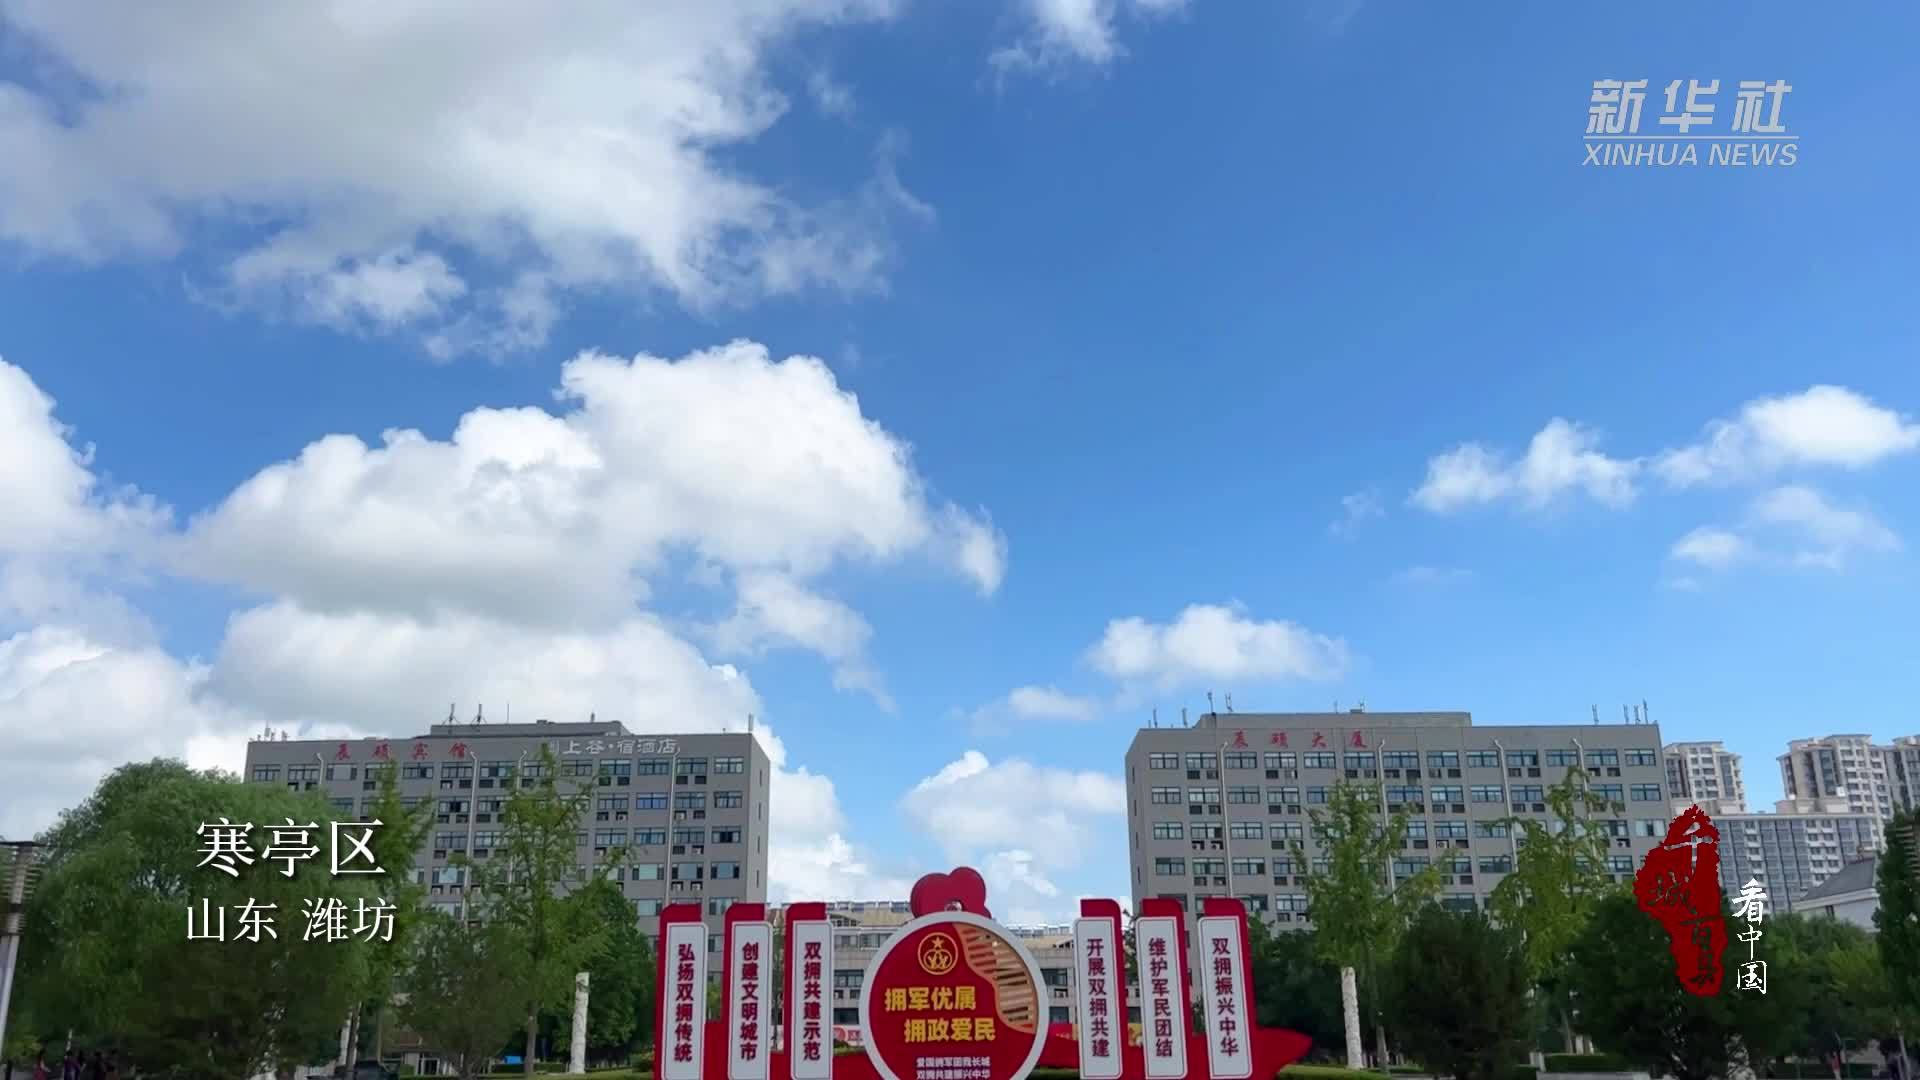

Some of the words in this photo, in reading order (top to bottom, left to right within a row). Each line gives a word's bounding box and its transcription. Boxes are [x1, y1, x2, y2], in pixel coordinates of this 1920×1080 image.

[674, 943, 696, 1062] 弘扬双拥传统
[740, 942, 759, 1062] 创建文明城市
[803, 941, 822, 1062] 双拥共建示范
[884, 985, 977, 1012] 拥军优属
[904, 1017, 996, 1043] 拥政爱民
[1086, 938, 1110, 1057] 开展双拥共建
[1148, 937, 1173, 1057] 维护军民团结
[1211, 937, 1239, 1057] 双拥振兴中华
